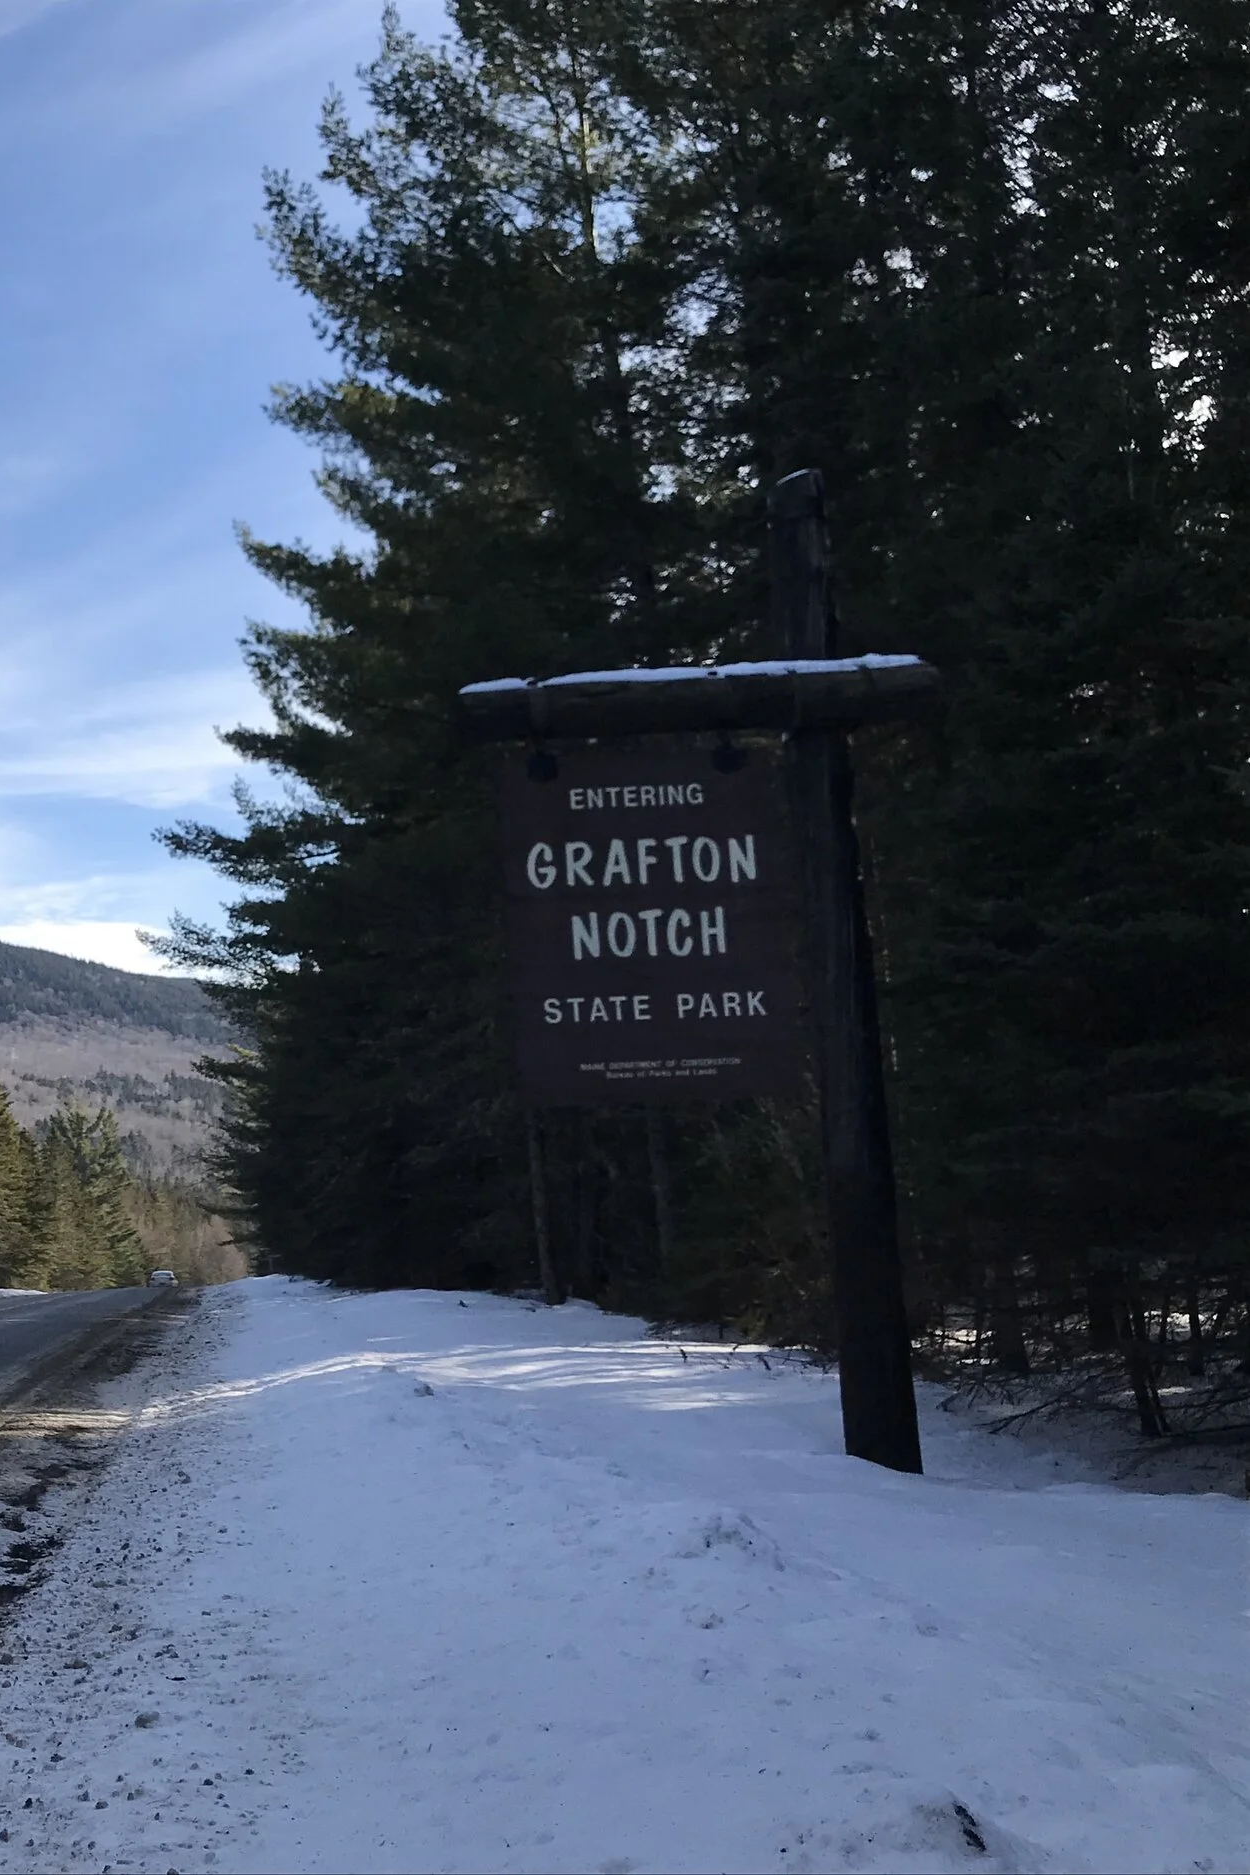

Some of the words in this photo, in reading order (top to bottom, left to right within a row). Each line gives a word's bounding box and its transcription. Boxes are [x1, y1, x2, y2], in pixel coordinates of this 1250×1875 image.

[569, 783, 704, 810] ENTERING
[526, 834, 757, 890] GRAFTON
[571, 905, 727, 961] NOTCH
[543, 994, 652, 1024] STATE
[676, 990, 767, 1019] PARK
